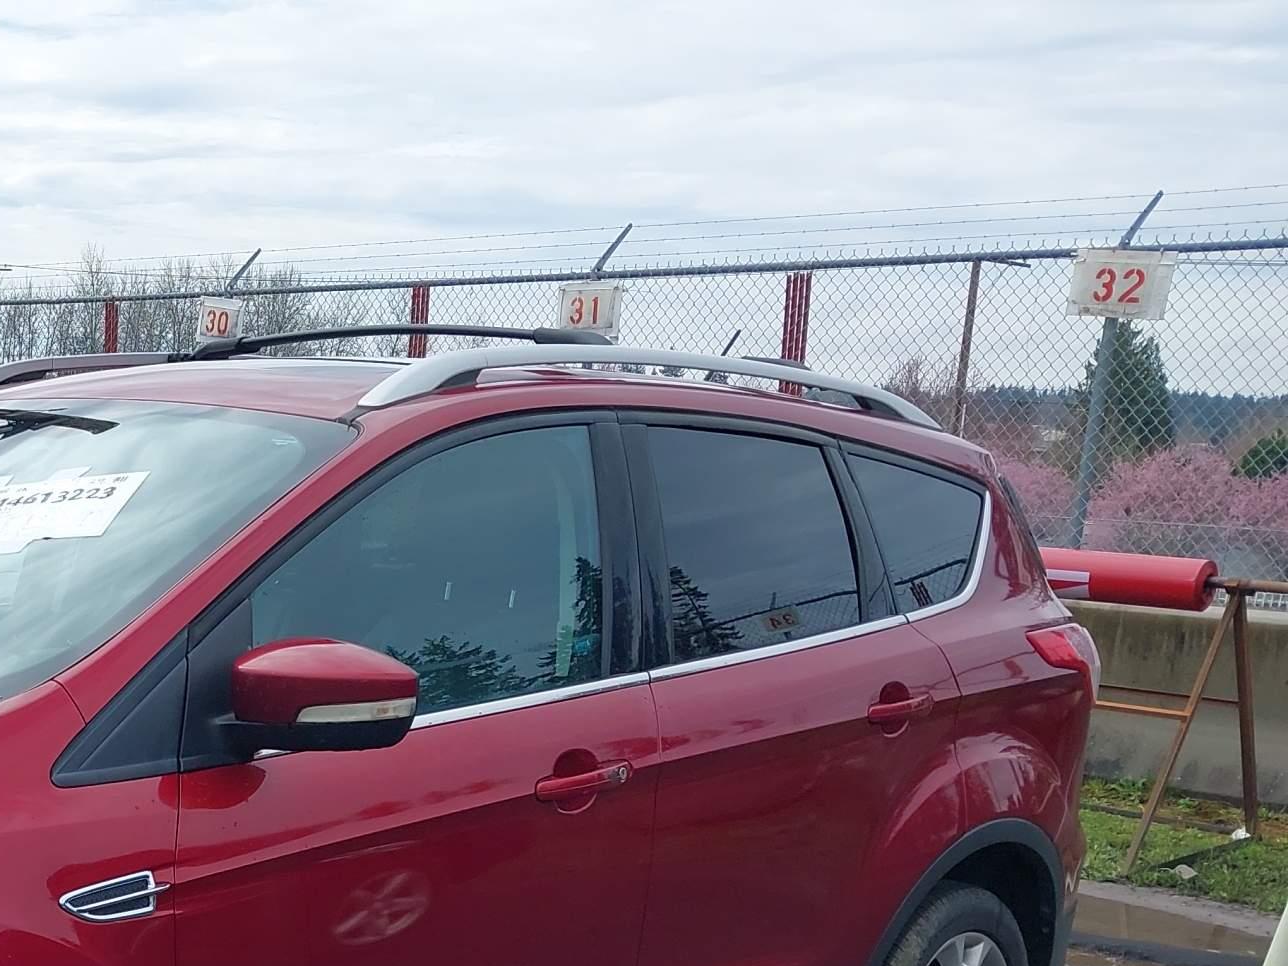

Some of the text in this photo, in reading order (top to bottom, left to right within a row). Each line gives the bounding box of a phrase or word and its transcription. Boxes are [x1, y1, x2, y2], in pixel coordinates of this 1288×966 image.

[1093, 267, 1146, 303] 32
[205, 309, 230, 335] 30
[569, 295, 600, 325] 31
